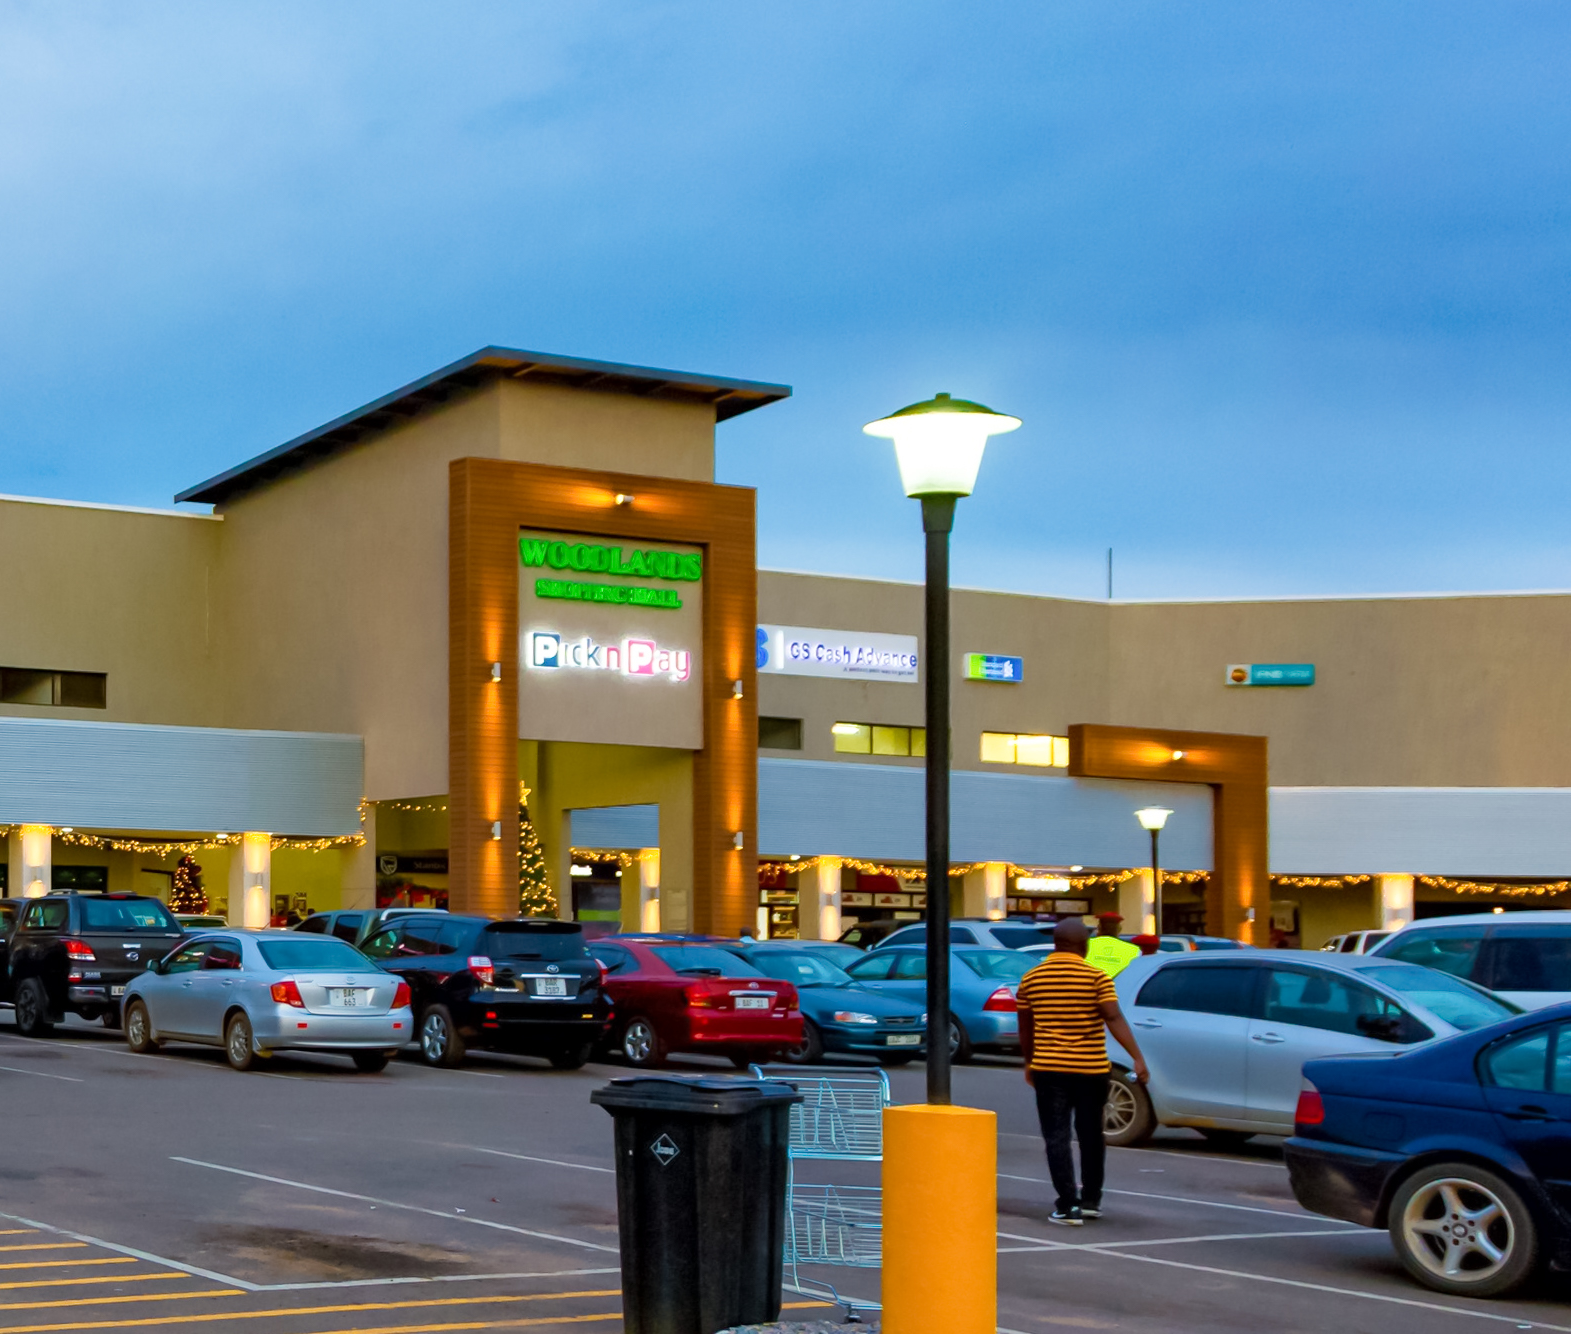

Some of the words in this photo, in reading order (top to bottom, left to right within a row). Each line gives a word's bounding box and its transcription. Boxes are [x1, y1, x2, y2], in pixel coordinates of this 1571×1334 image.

[519, 538, 701, 581] WOODLANDS
[532, 632, 601, 668] Pick
[628, 639, 691, 682] Pay
[790, 642, 810, 660] GS
[815, 644, 851, 664] Cash
[856, 647, 918, 668] Advance
